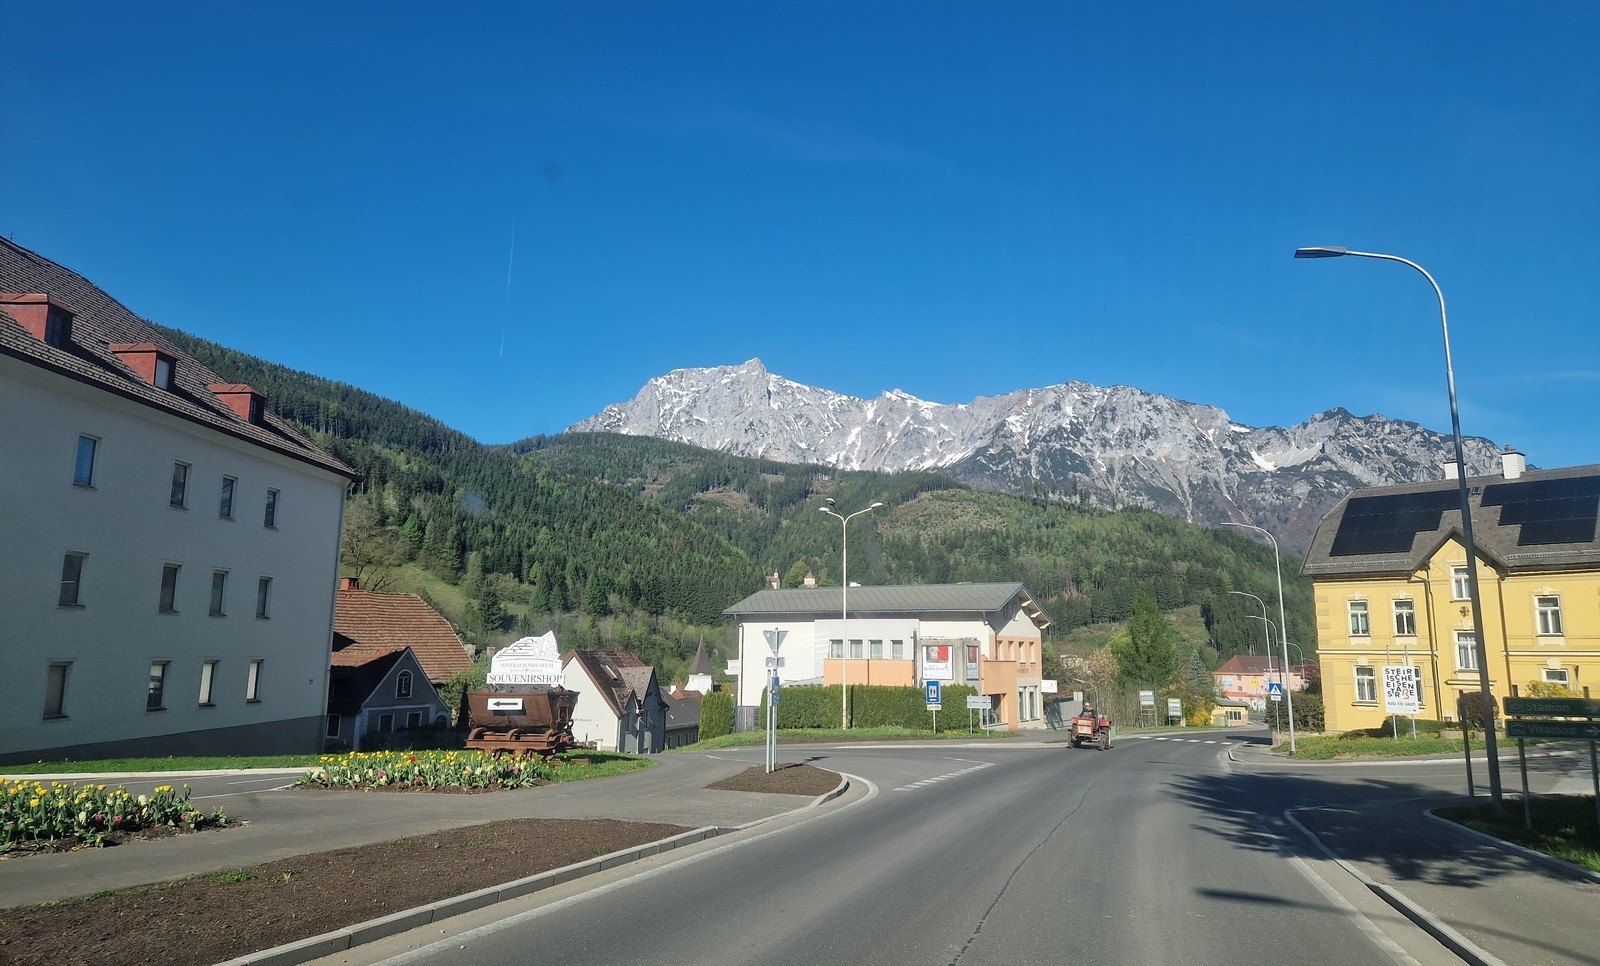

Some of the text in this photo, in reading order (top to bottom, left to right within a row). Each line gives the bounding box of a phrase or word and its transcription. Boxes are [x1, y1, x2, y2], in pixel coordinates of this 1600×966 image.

[489, 674, 562, 682] SOUVENIRSHOP
[1386, 680, 1414, 689] EISEN
[1527, 703, 1570, 712] Stadion
